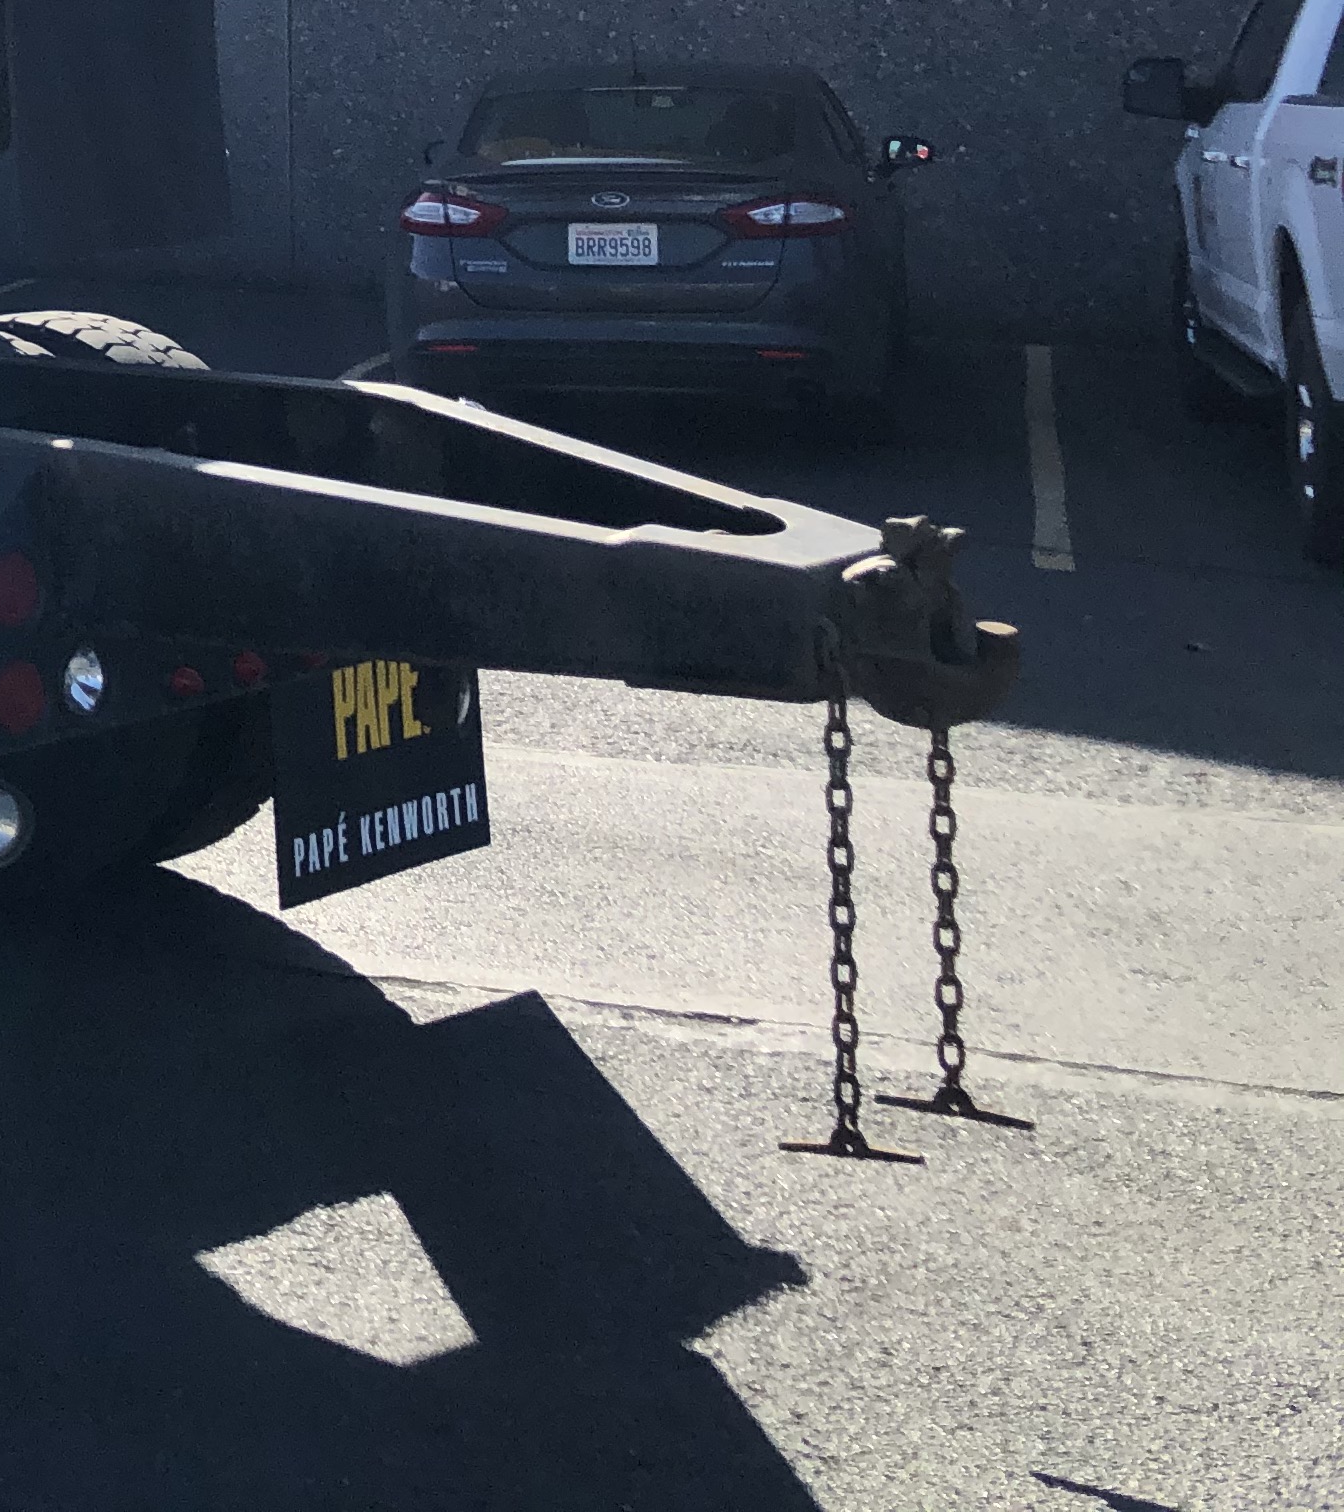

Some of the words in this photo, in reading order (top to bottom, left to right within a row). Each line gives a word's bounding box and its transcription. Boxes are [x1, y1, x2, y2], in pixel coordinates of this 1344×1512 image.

[575, 236, 652, 257] BRR9598
[293, 812, 349, 877] PAPÉ
[360, 783, 479, 855] KENWORTH
